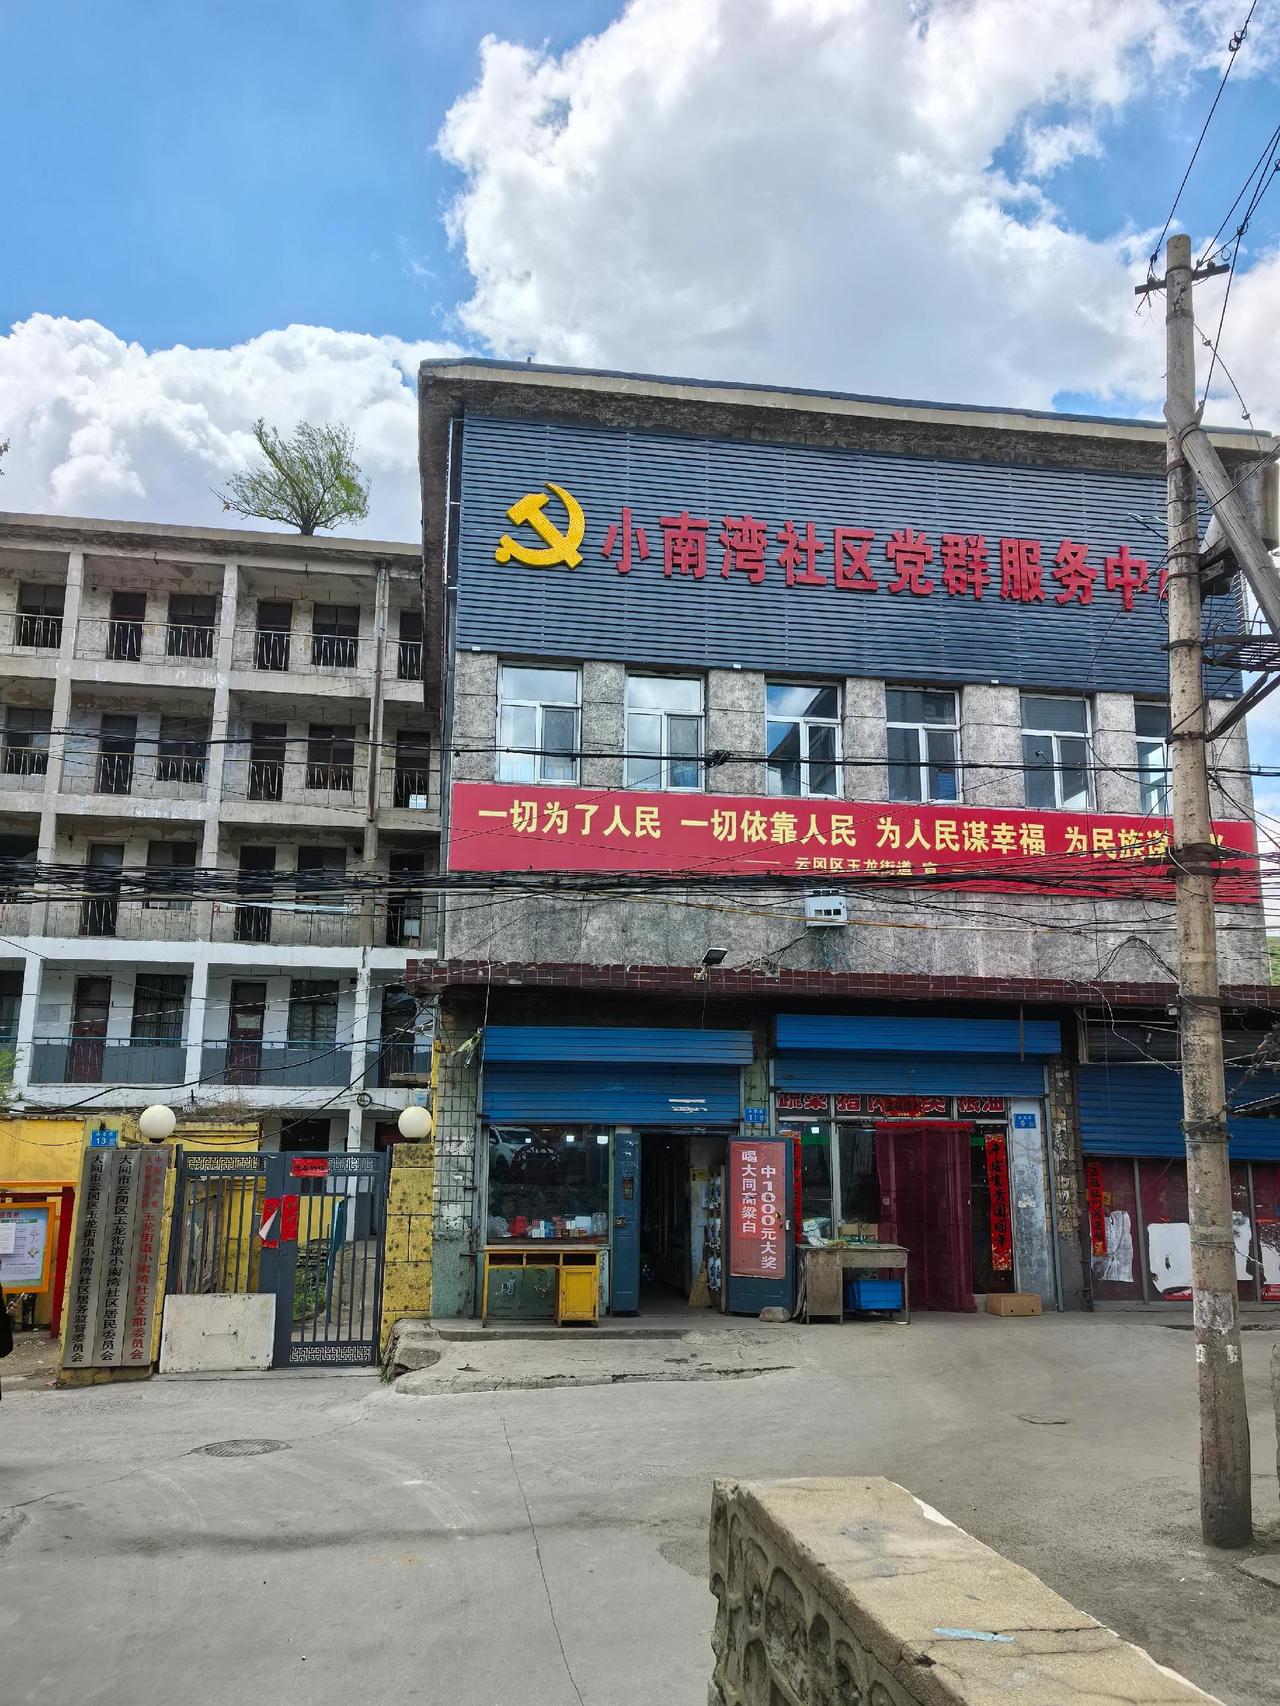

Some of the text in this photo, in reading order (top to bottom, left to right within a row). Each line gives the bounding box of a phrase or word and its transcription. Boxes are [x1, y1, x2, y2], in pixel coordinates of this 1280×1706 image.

[601, 506, 1168, 611] 小南湾社区党群服务中
[478, 800, 661, 839] 一切为了人民
[681, 809, 857, 847] 一切依靠人民
[876, 818, 1046, 856] 为人民谋幸福
[761, 1165, 777, 1270] 中1000元大奖
